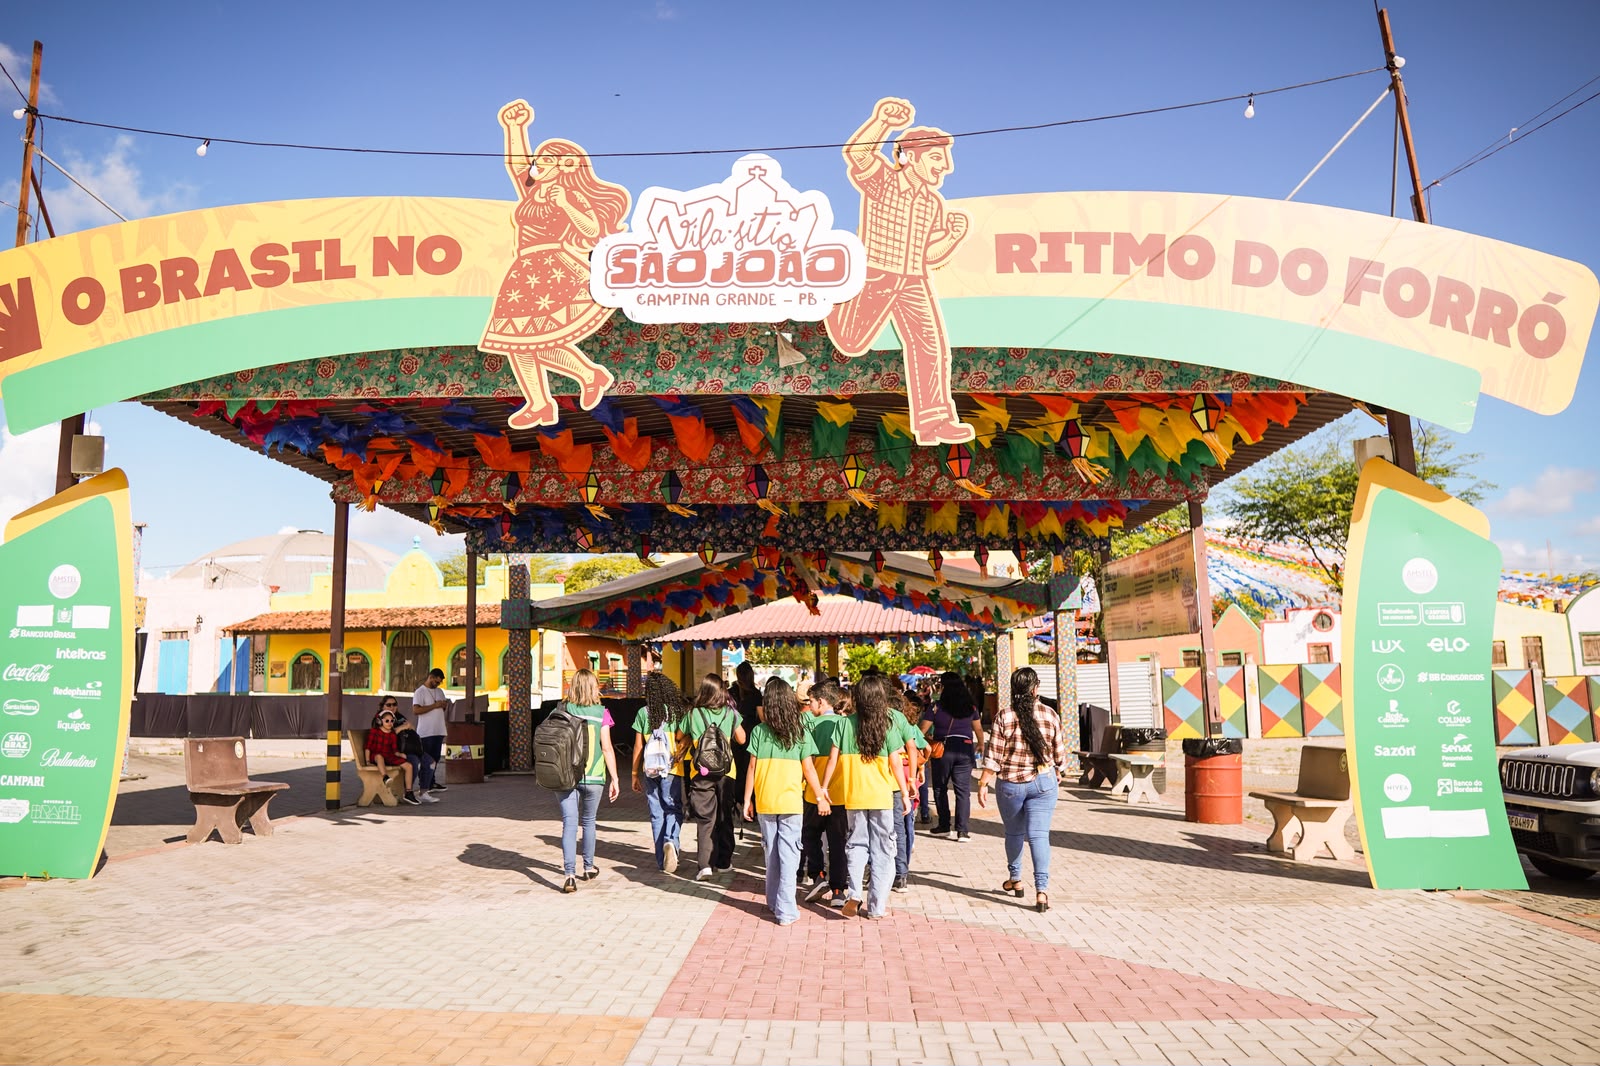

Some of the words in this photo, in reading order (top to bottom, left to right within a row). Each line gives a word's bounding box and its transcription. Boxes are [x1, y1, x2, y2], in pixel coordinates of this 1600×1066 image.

[657, 207, 727, 251] Vila
[608, 241, 707, 286] SÃO
[709, 243, 848, 286] JOÃO
[61, 276, 106, 326] O
[119, 238, 356, 315] BRASIL
[372, 234, 463, 277] NO
[636, 292, 710, 306] CAMPINA
[715, 292, 777, 307] GRANDE
[798, 292, 818, 306] PB
[994, 231, 1216, 281] RITMO
[1231, 239, 1329, 297] DO
[1342, 255, 1567, 359] FORRÓ
[53, 630, 76, 639] BRASIL
[1371, 639, 1406, 654] LUX
[53, 686, 102, 698] Redepharma
[4, 741, 28, 749] BRAZ
[1374, 745, 1416, 757] Sazón
[0, 775, 45, 787] CAMPARI
[31, 804, 81, 820] BRASIL
